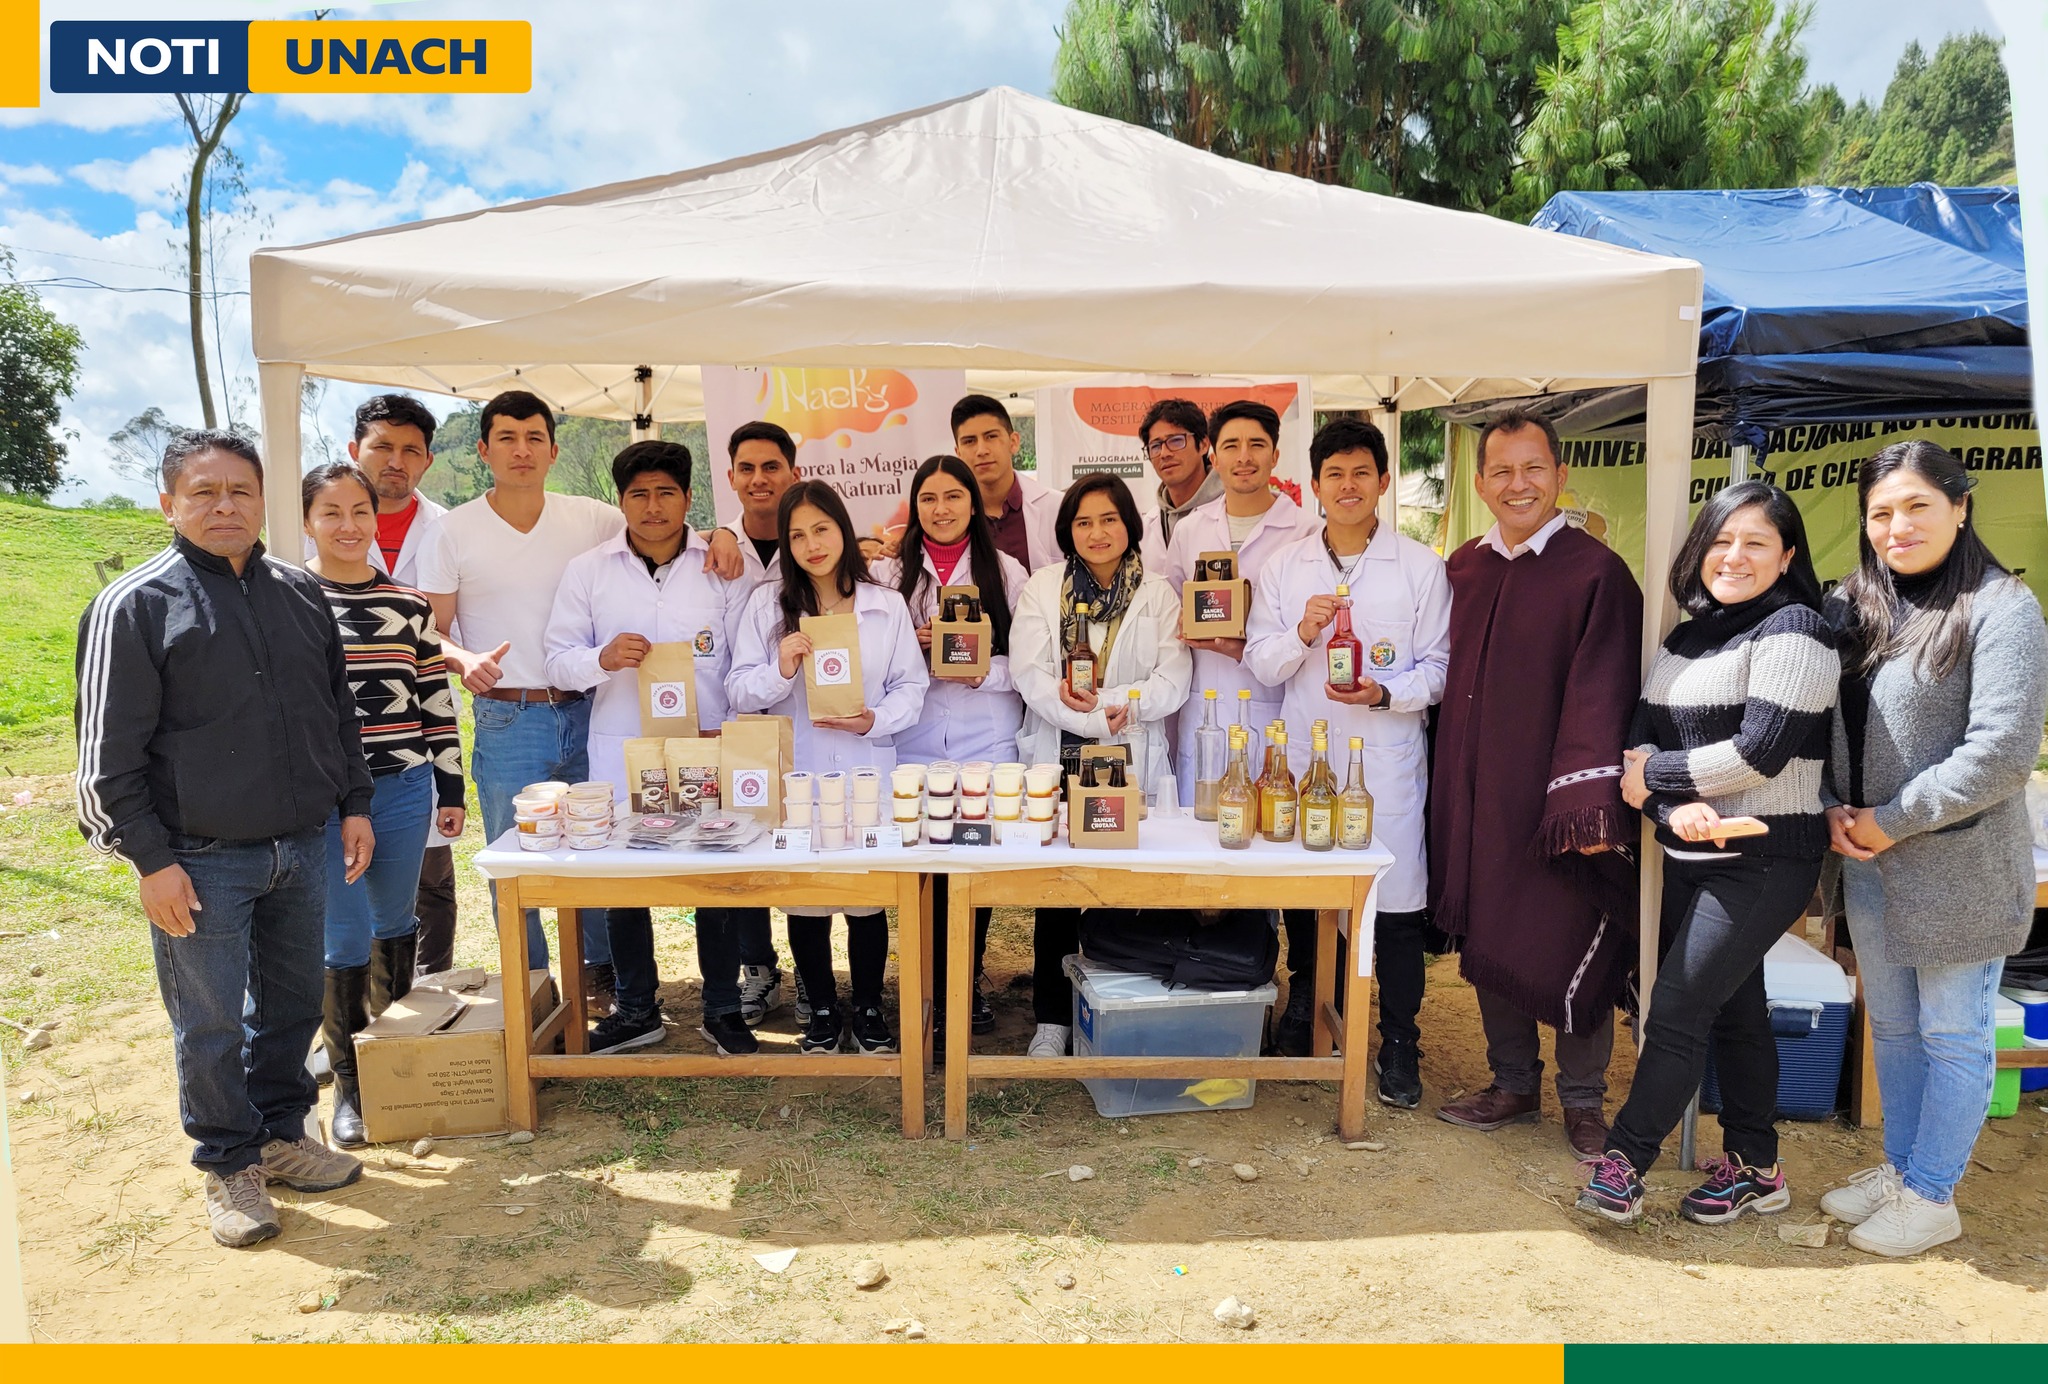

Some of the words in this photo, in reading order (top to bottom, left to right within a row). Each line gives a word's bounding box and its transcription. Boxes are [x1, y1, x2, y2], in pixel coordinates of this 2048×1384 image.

[1090, 401, 1151, 412] MACERA
[1752, 423, 1875, 454] ACIONAL
[800, 464, 835, 477] orea
[840, 458, 855, 475] la
[860, 453, 919, 476] Magia
[1079, 455, 1140, 463] FLUJOGRAMA
[832, 478, 901, 499] Natural
[1786, 465, 1817, 491] DE
[394, 1102, 422, 1111] Clamshell
